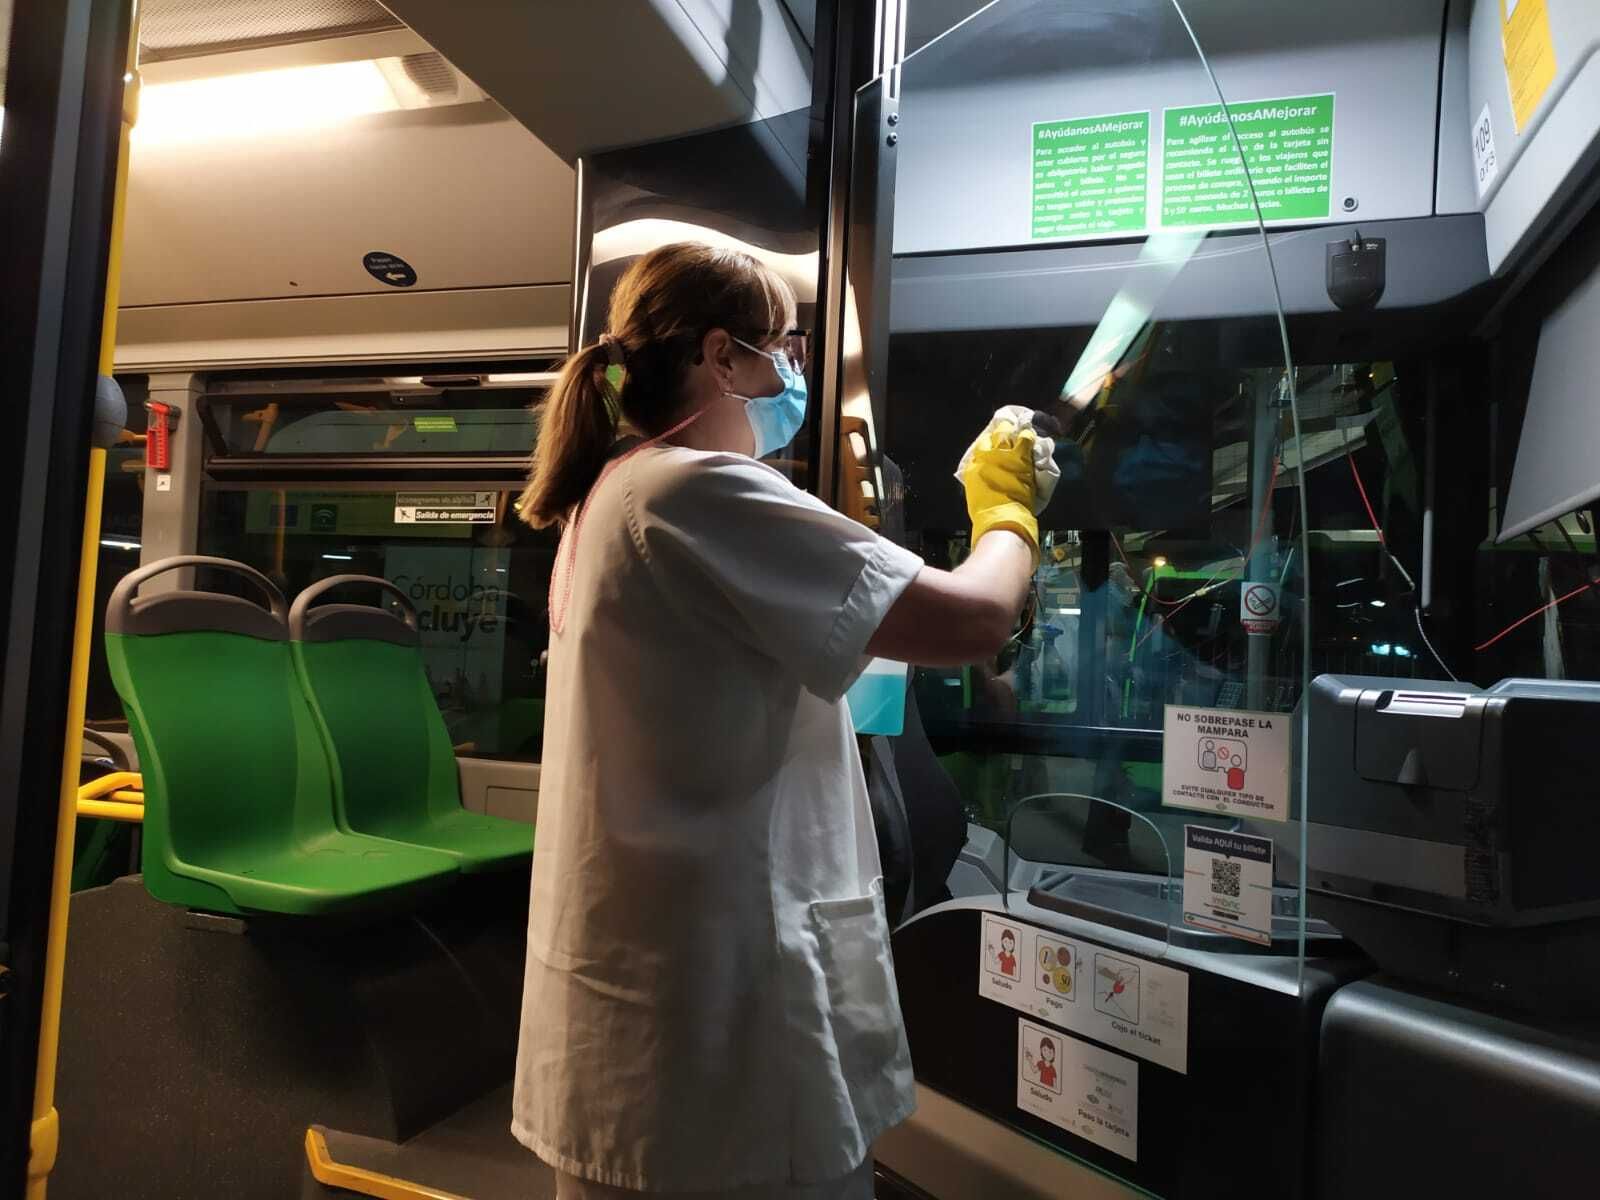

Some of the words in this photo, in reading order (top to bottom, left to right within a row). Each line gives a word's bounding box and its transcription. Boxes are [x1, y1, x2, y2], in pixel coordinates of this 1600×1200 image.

[1179, 106, 1317, 127] #AyúdanosAMejorar
[1039, 120, 1144, 139] #AyúdanosAMejorar
[1167, 137, 1184, 146] Para
[1281, 127, 1315, 136] autobús
[1254, 142, 1264, 151] de
[1270, 141, 1278, 149] la
[1284, 140, 1311, 148] tarjeta
[1476, 118, 1491, 158] 109
[1275, 151, 1308, 161] viajeros
[1312, 150, 1329, 158] que
[1284, 162, 1318, 171] faciliten
[1284, 175, 1292, 183] el
[1294, 173, 1327, 183] importe
[1284, 186, 1315, 195] billetes
[1317, 184, 1328, 192] de
[451, 511, 493, 520] emergencia
[417, 604, 498, 642] cluye
[1177, 713, 1191, 722] NO
[1194, 715, 1255, 727] SOBREPASE
[1259, 719, 1272, 729] LA
[1197, 725, 1249, 738] MAMPARA
[1173, 790, 1205, 800] CONTACTO
[1233, 798, 1274, 810] CONDUCTOR
[1201, 787, 1236, 797] CUALQUIER
[1192, 833, 1213, 844] Valida
[1214, 838, 1233, 848] AQUÍ
[1243, 843, 1266, 854] billete
[991, 977, 1013, 991] Saludo
[1046, 997, 1063, 1009] Pago
[1111, 1021, 1128, 1035] Cojo
[1138, 1030, 1161, 1046] ticket
[1030, 1087, 1053, 1103] Saludo
[1078, 1108, 1095, 1121] Paso
[1097, 1118, 1104, 1126] la
[1104, 1121, 1130, 1138] tarjeta
